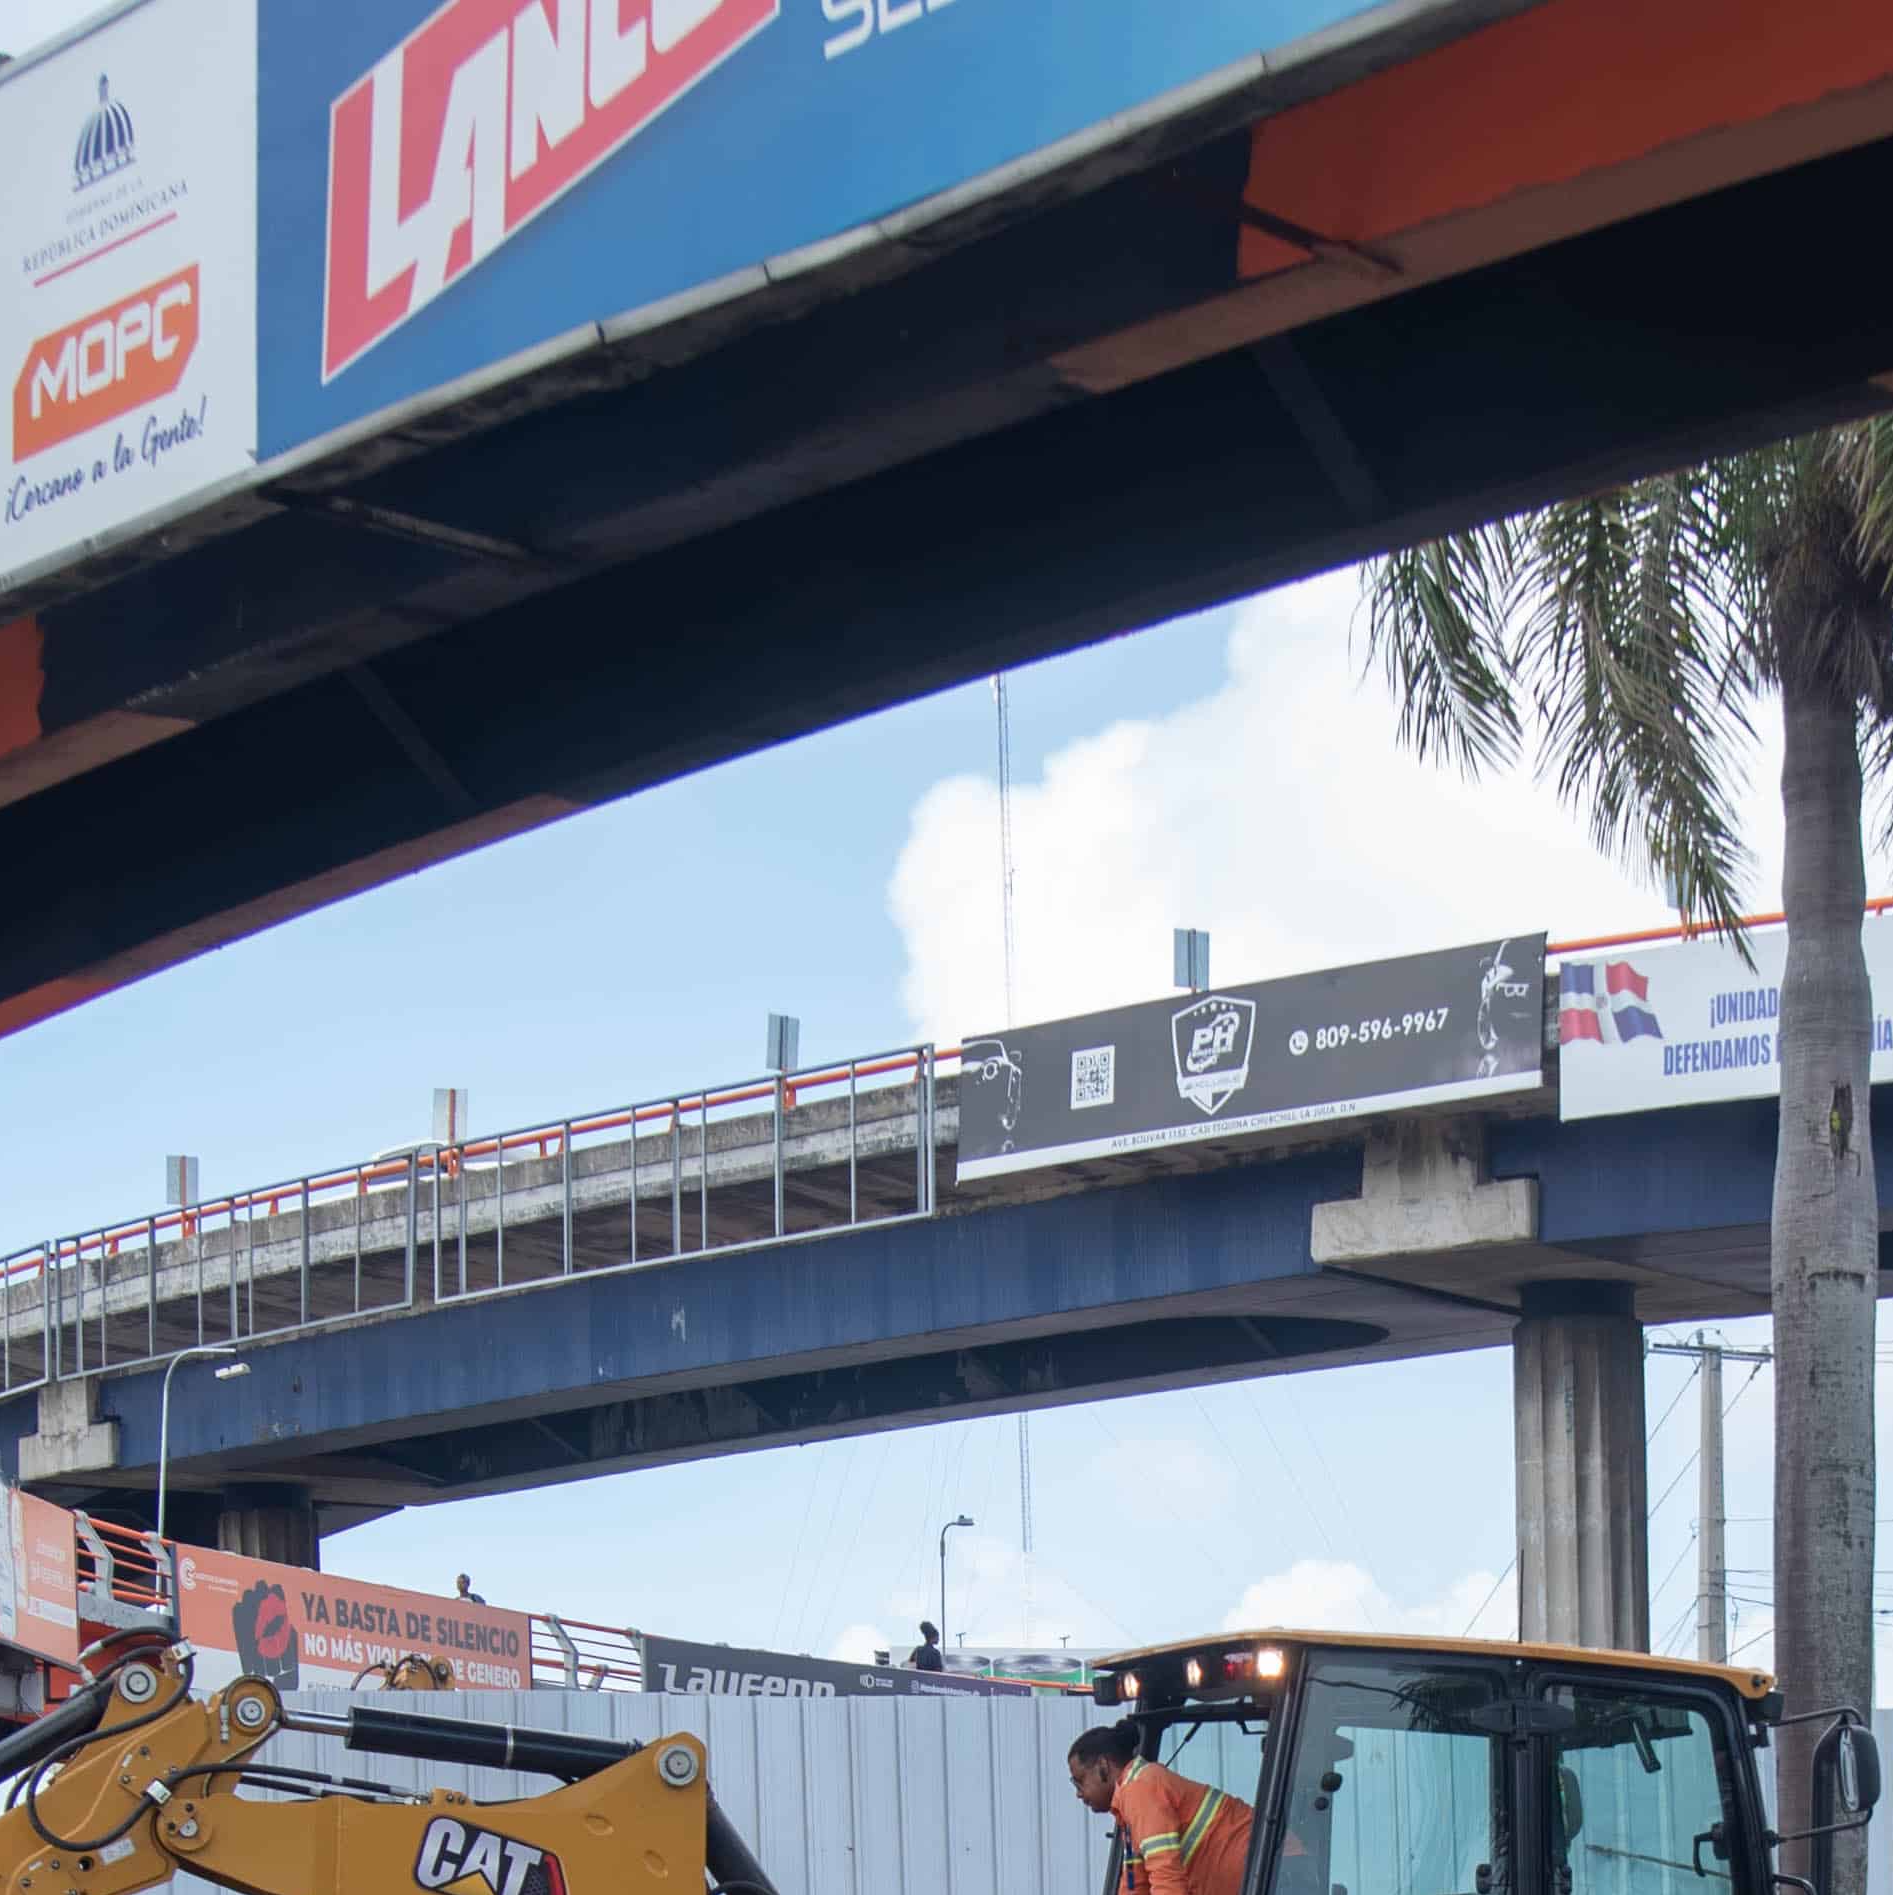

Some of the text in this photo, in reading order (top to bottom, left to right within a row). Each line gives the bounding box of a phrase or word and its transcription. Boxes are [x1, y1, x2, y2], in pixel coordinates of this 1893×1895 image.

[31, 281, 191, 421] MOPC
[92, 458, 106, 484] a
[113, 432, 134, 473] la
[140, 394, 206, 467] Gente!
[1315, 1007, 1449, 1050] 809-596-9967
[1663, 1033, 1771, 1077] DEFENDAMOS
[301, 1592, 519, 1658] YA BASTA DE SILENCIO
[304, 1633, 326, 1656] NO
[331, 1635, 363, 1664] MÁS
